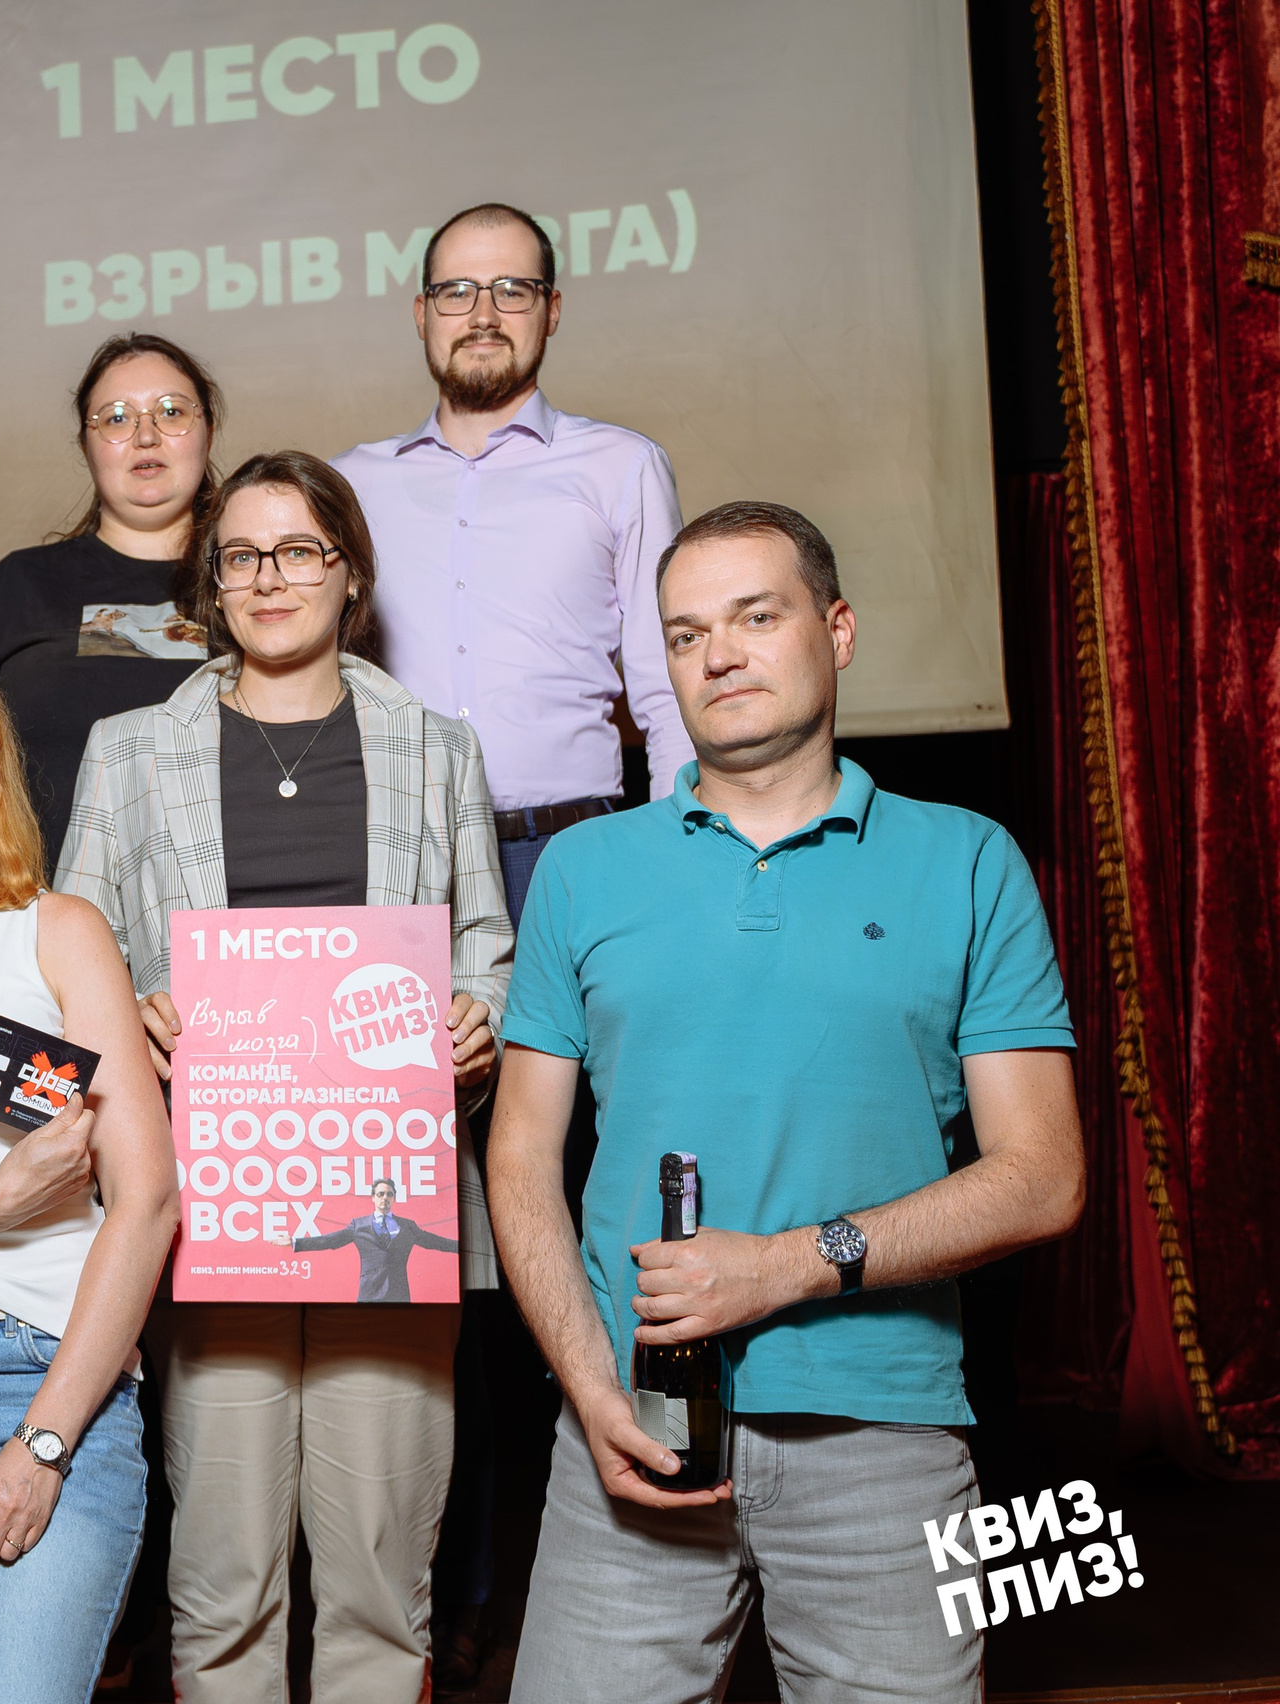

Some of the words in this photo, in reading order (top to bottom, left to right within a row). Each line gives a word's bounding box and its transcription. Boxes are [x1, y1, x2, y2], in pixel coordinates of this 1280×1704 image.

[40, 62, 82, 139] 1
[114, 23, 480, 133] МЕСТО
[44, 236, 342, 326] ВЗРЫВ
[365, 188, 697, 297] МГА)
[190, 929, 205, 960] 1
[220, 926, 358, 960] МЕСТО
[189, 997, 277, 1037] Взрыв
[329, 976, 432, 1025] КВИЗ,
[334, 1004, 438, 1055] ПЛИЗ!
[189, 1064, 298, 1084] КОМАНДЕ,
[15, 1092, 61, 1113] COMMUNIT
[189, 1087, 286, 1105] КОТОРАЯ
[291, 1086, 400, 1104] РАЗНЕСЛА
[189, 1201, 324, 1242] ВСЕХ
[190, 1266, 215, 1275] КВИЗ,
[216, 1266, 241, 1274] ПЛИЗ!
